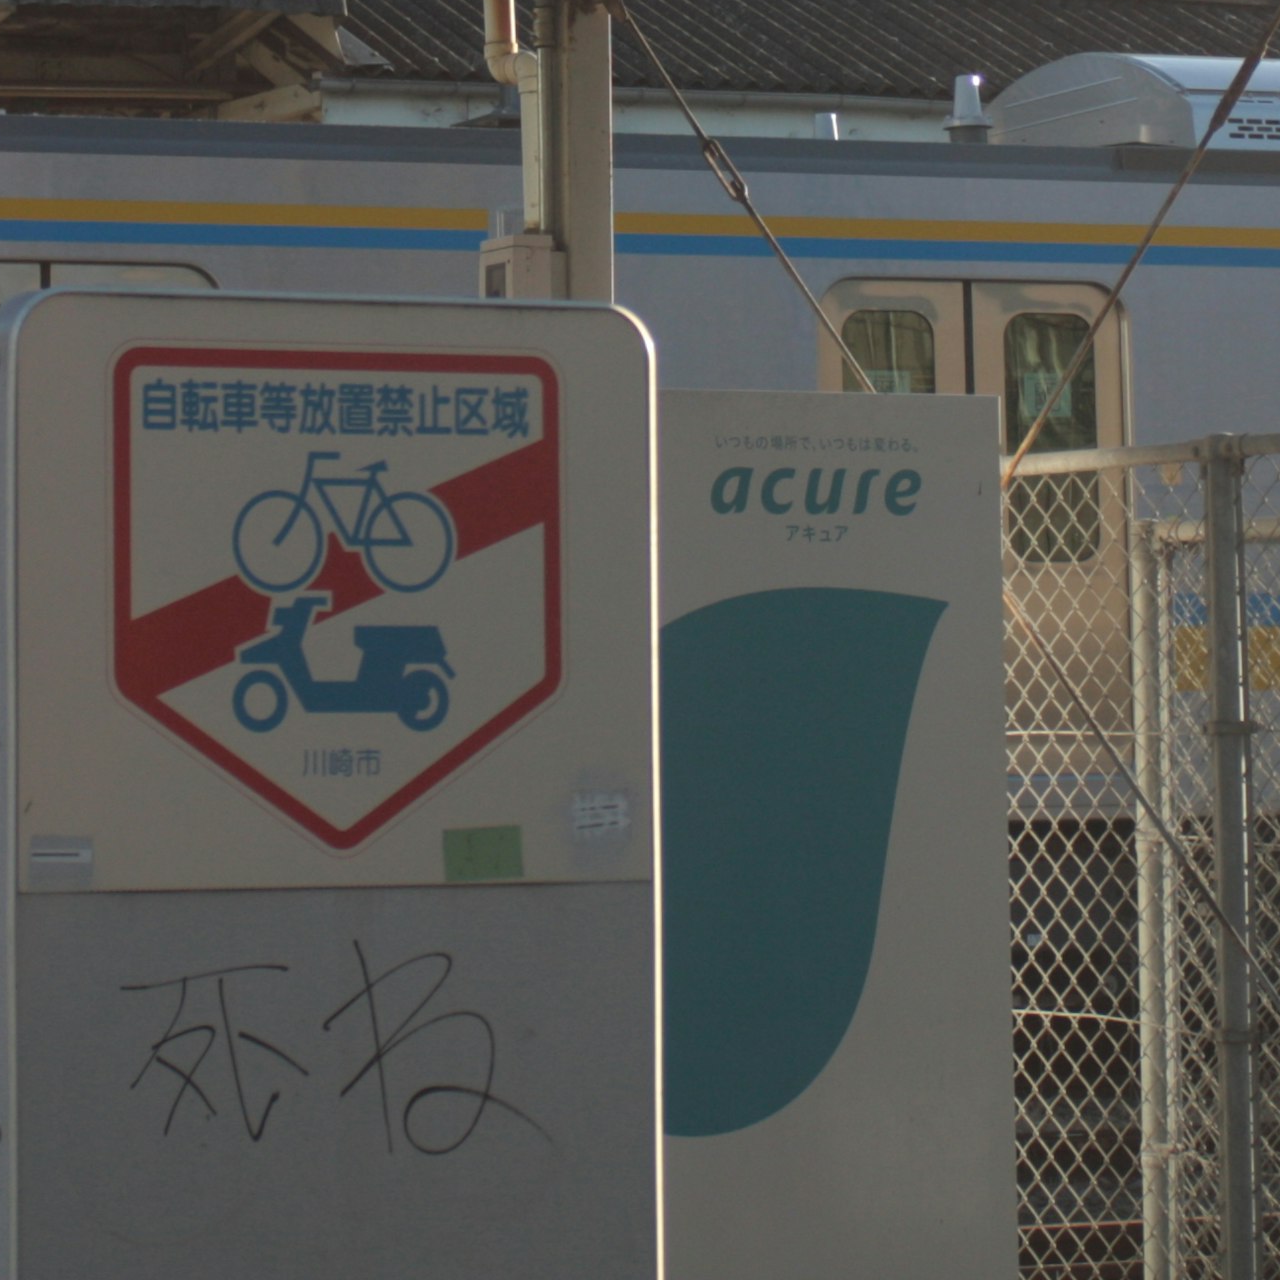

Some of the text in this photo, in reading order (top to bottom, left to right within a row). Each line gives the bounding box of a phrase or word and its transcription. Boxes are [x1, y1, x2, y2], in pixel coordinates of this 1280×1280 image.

[141, 378, 531, 440] 自転車等放置禁止区域
[709, 466, 923, 517] acure
[785, 524, 849, 543] アキュア
[301, 748, 382, 778] 川崎市
